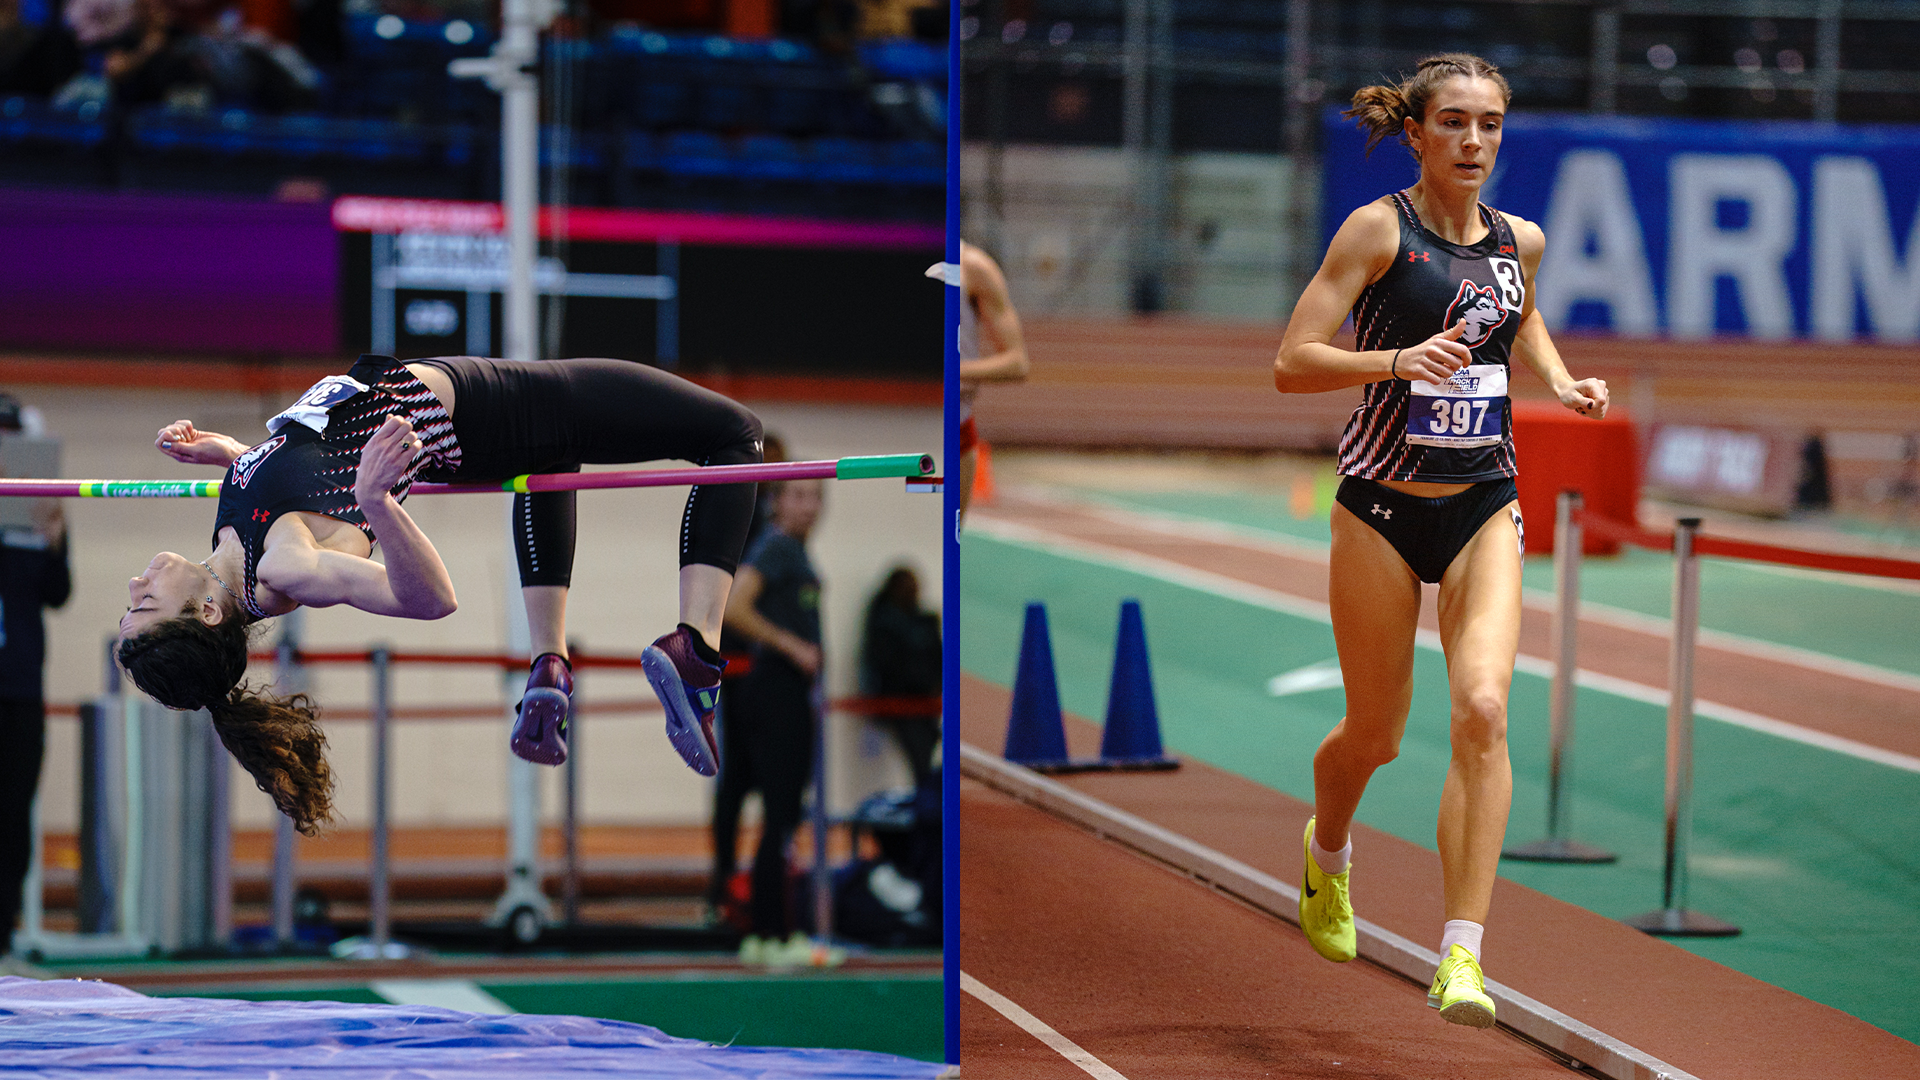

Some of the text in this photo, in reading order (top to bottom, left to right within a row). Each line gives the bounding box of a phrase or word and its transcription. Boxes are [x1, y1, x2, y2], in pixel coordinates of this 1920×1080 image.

[1499, 245, 1515, 254] CAA
[1497, 261, 1522, 307] 3
[1429, 399, 1490, 436] 397
